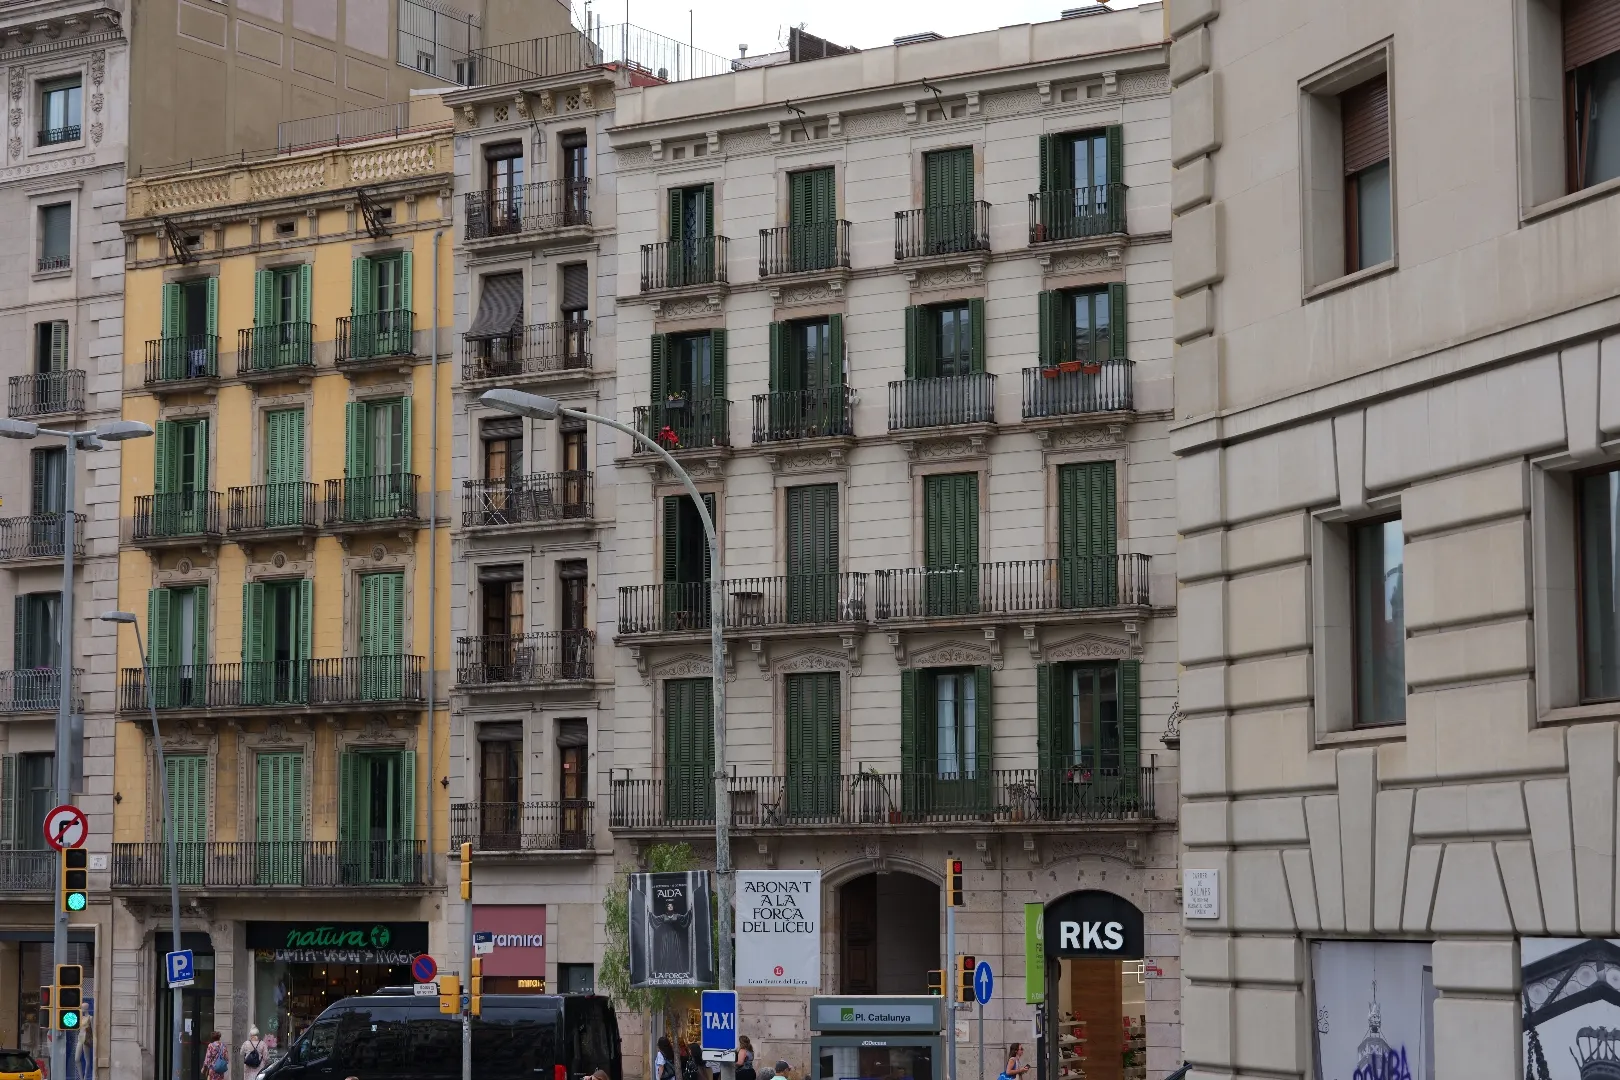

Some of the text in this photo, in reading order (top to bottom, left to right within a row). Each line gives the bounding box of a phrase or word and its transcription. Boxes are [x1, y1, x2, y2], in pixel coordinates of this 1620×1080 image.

[657, 888, 683, 898] AIDA
[744, 881, 812, 893] ABONA'T
[760, 894, 797, 906] A LA
[753, 907, 805, 922] FORÇA
[742, 921, 815, 933] DEL LICEU
[287, 925, 368, 948] natura
[1060, 921, 1124, 950] RKS
[172, 954, 188, 978] P
[704, 1011, 734, 1030] TAXI
[855, 1013, 911, 1023] Pl. Catalunya
